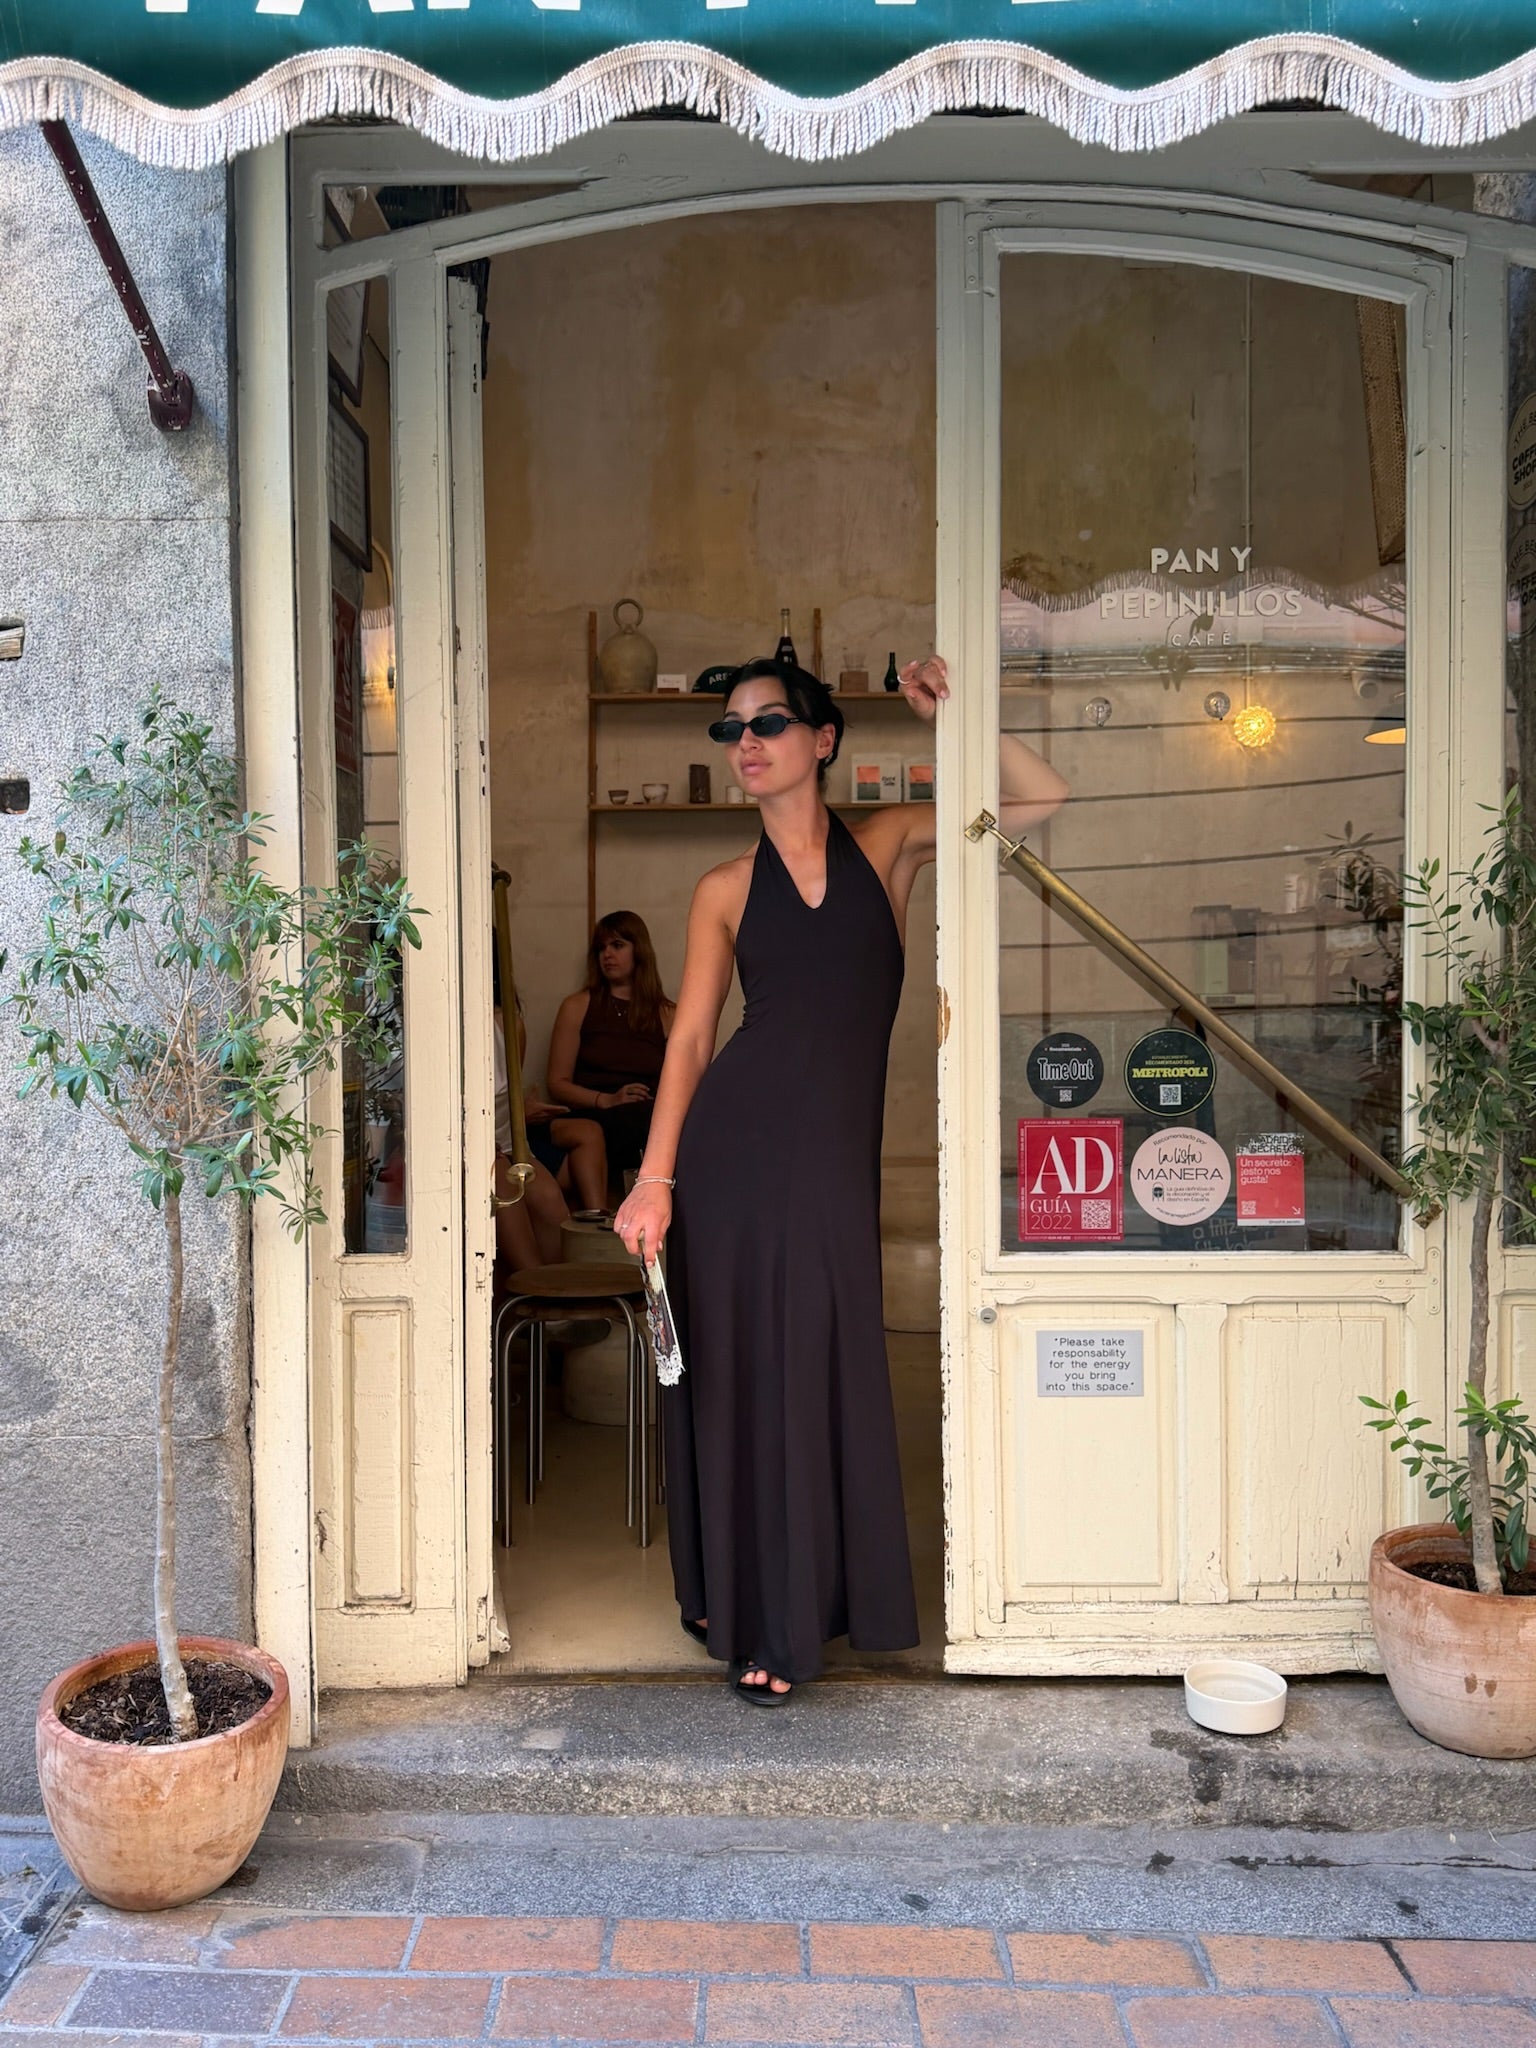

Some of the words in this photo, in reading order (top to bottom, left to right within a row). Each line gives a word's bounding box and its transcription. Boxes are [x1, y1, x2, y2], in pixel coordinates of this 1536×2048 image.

[1150, 547, 1219, 574] PAN
[1230, 546, 1252, 572] Y
[1100, 590, 1302, 619] PEPINILLOS
[1171, 631, 1232, 646] CAFÉ
[1037, 1056, 1069, 1081] Time
[1069, 1057, 1095, 1081] Out
[1132, 1066, 1208, 1078] METROPOLI
[1030, 1135, 1115, 1195] AD
[1240, 1158, 1254, 1167] Un
[1136, 1168, 1224, 1181] MANERA
[1264, 1168, 1281, 1176] nos
[1030, 1195, 1072, 1214] GUÍA
[1031, 1214, 1073, 1230] 2022
[1101, 1337, 1125, 1347] take
[1052, 1349, 1127, 1359] responsability
[1049, 1360, 1064, 1369] for
[1071, 1360, 1088, 1369] the
[1093, 1360, 1131, 1370] energy
[1064, 1372, 1085, 1382] you
[1090, 1371, 1116, 1382] bring
[1045, 1382, 1066, 1391] into
[1071, 1382, 1090, 1391] this
